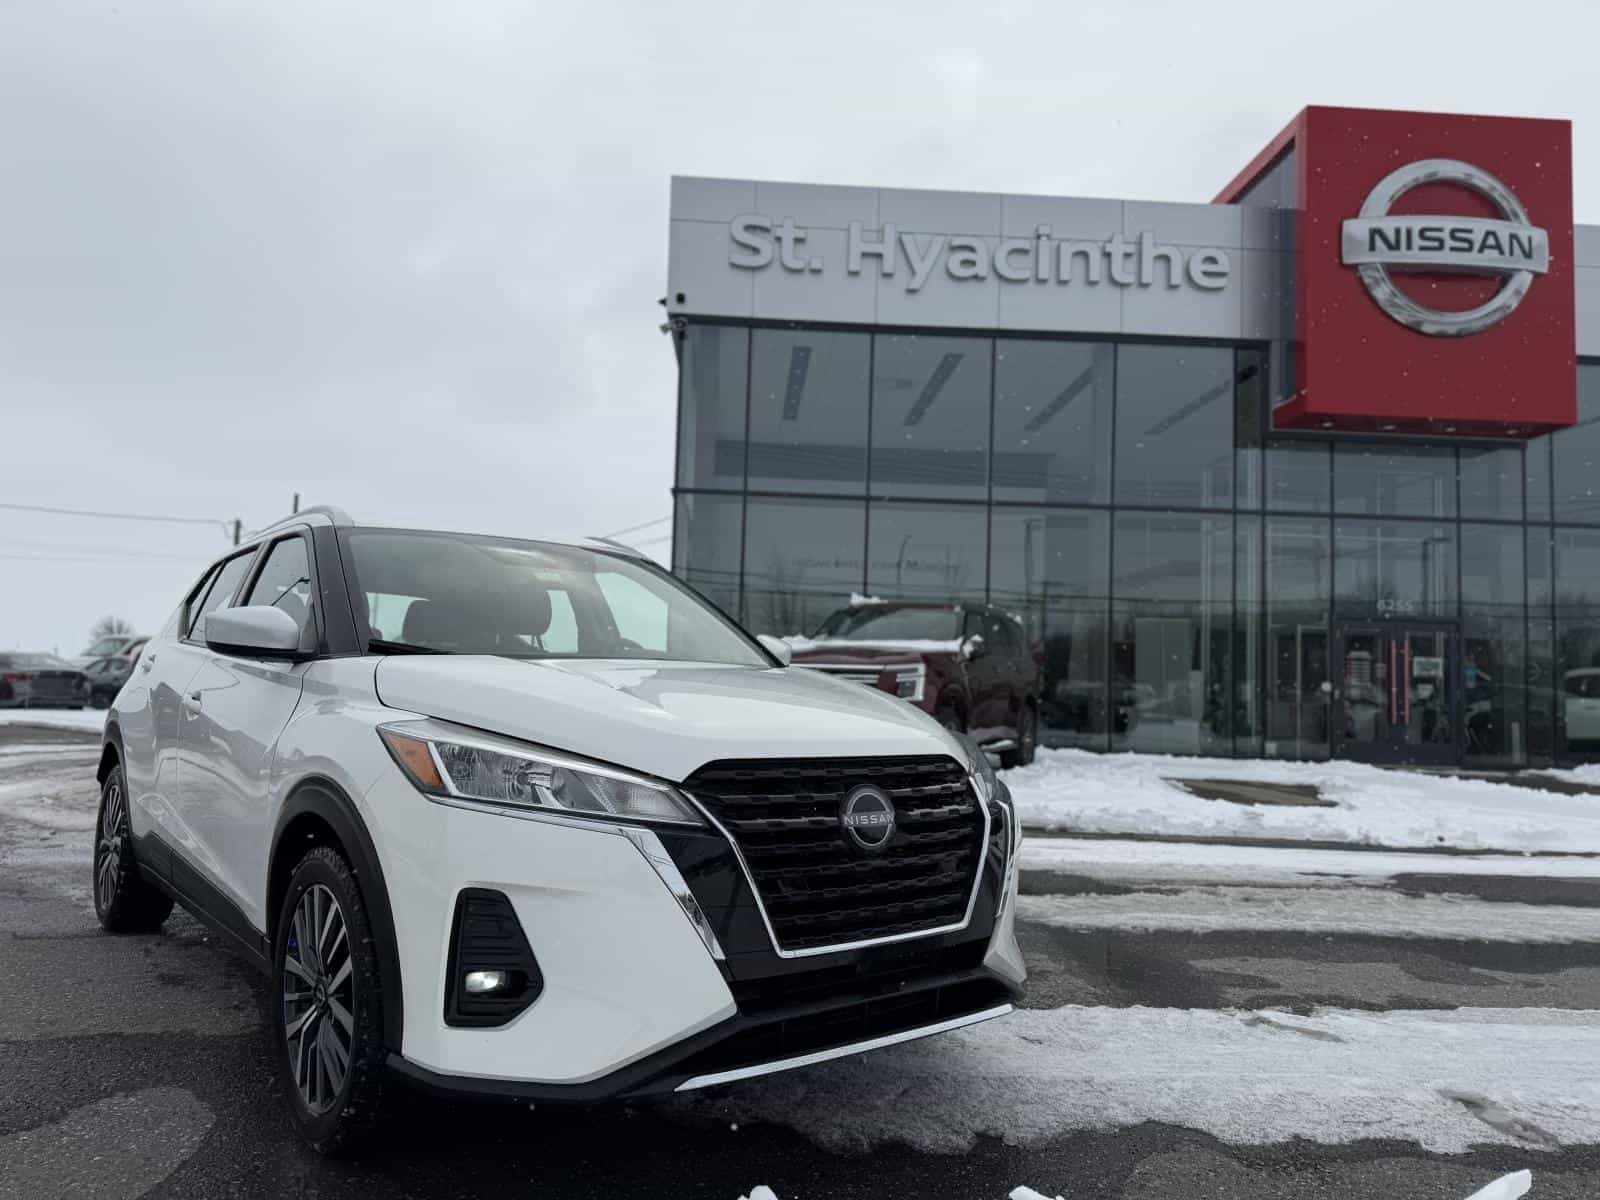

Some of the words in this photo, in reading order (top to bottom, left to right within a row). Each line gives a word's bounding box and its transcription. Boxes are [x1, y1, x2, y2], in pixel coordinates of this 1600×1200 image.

[729, 214, 823, 272] St.
[847, 221, 1230, 293] Hyacinthe
[1369, 227, 1533, 260] NISSAN
[843, 814, 895, 825] NISSAN
